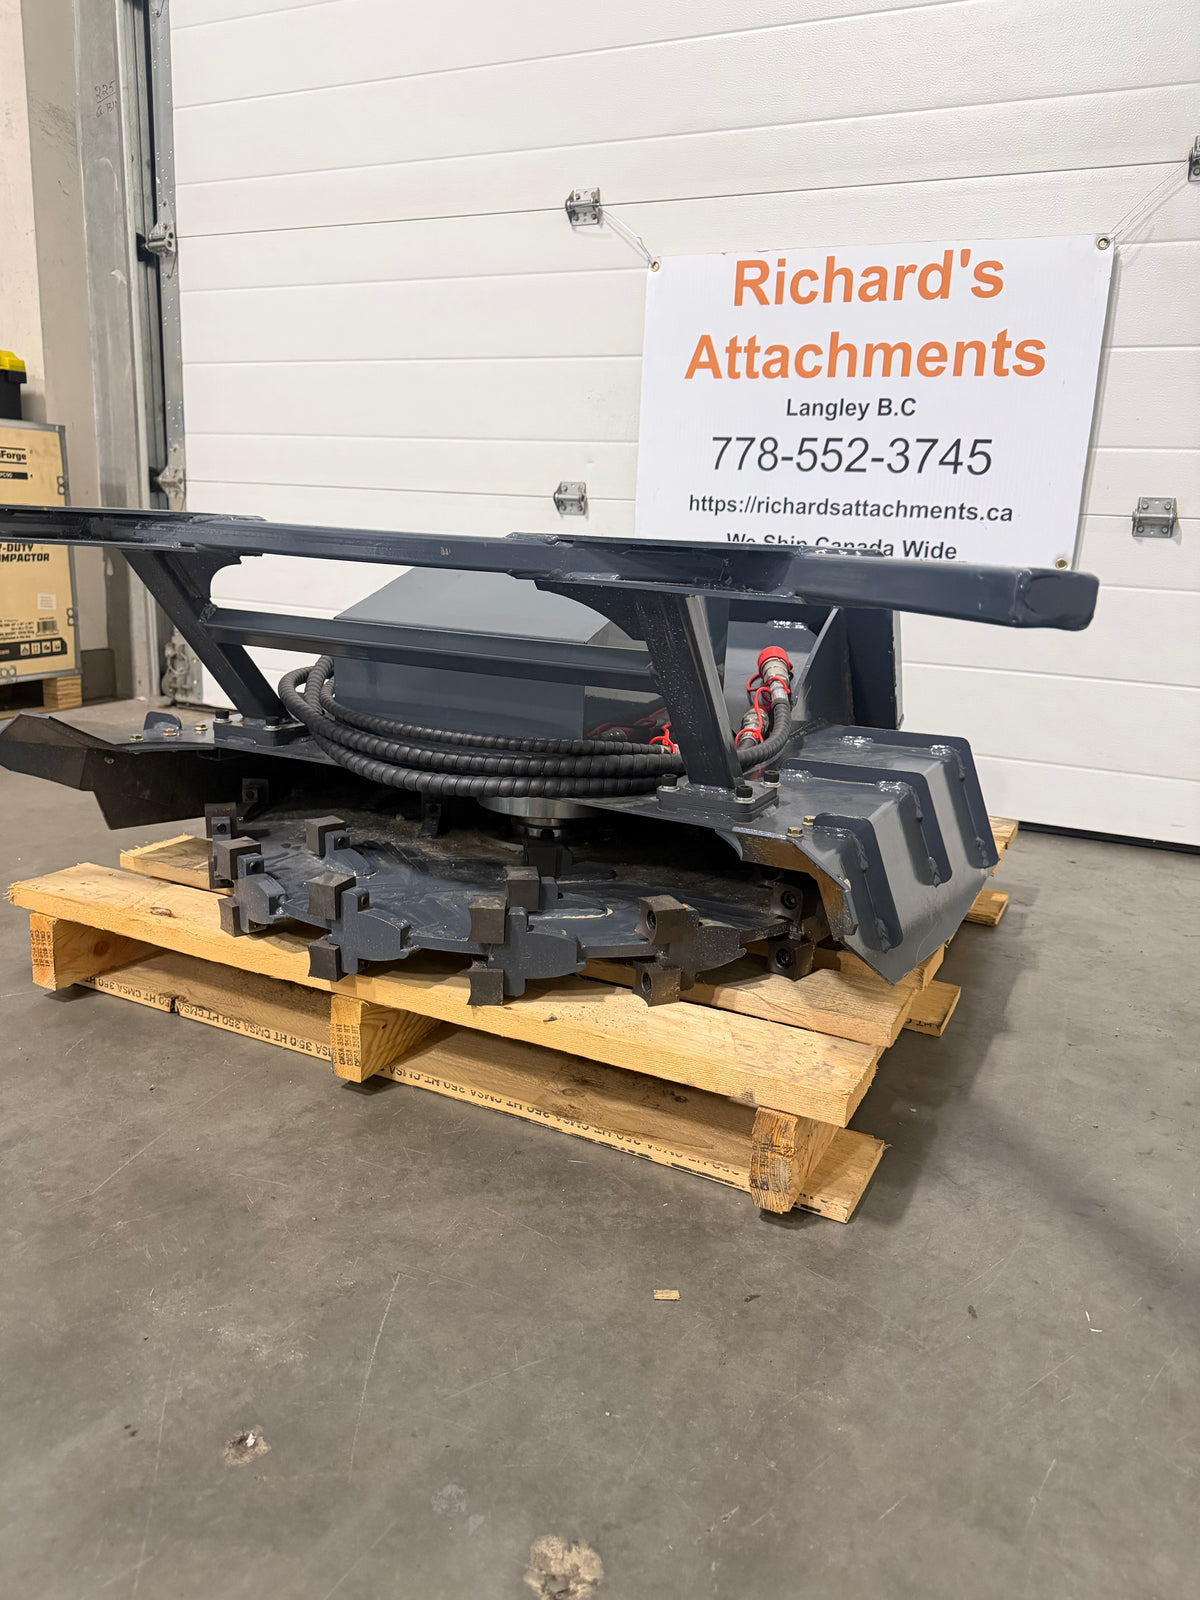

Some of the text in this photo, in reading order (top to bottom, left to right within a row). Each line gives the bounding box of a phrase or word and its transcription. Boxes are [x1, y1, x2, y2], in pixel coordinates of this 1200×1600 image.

[733, 249, 1004, 306] Richard's
[684, 328, 1046, 380] Attachments
[786, 398, 917, 420] Langley B.C
[0, 450, 27, 461] Forge
[711, 436, 993, 476] 778-552-3745
[688, 495, 1013, 522] https://richardsattachments.ca
[0, 553, 50, 562] MPACTOR
[902, 540, 957, 560] Wide
[117, 982, 142, 998] CMSA
[144, 994, 157, 1004] HT
[222, 1015, 241, 1030] 350
[244, 1022, 271, 1039] CMSA
[274, 1031, 288, 1044] HT
[290, 1036, 313, 1052] 350
